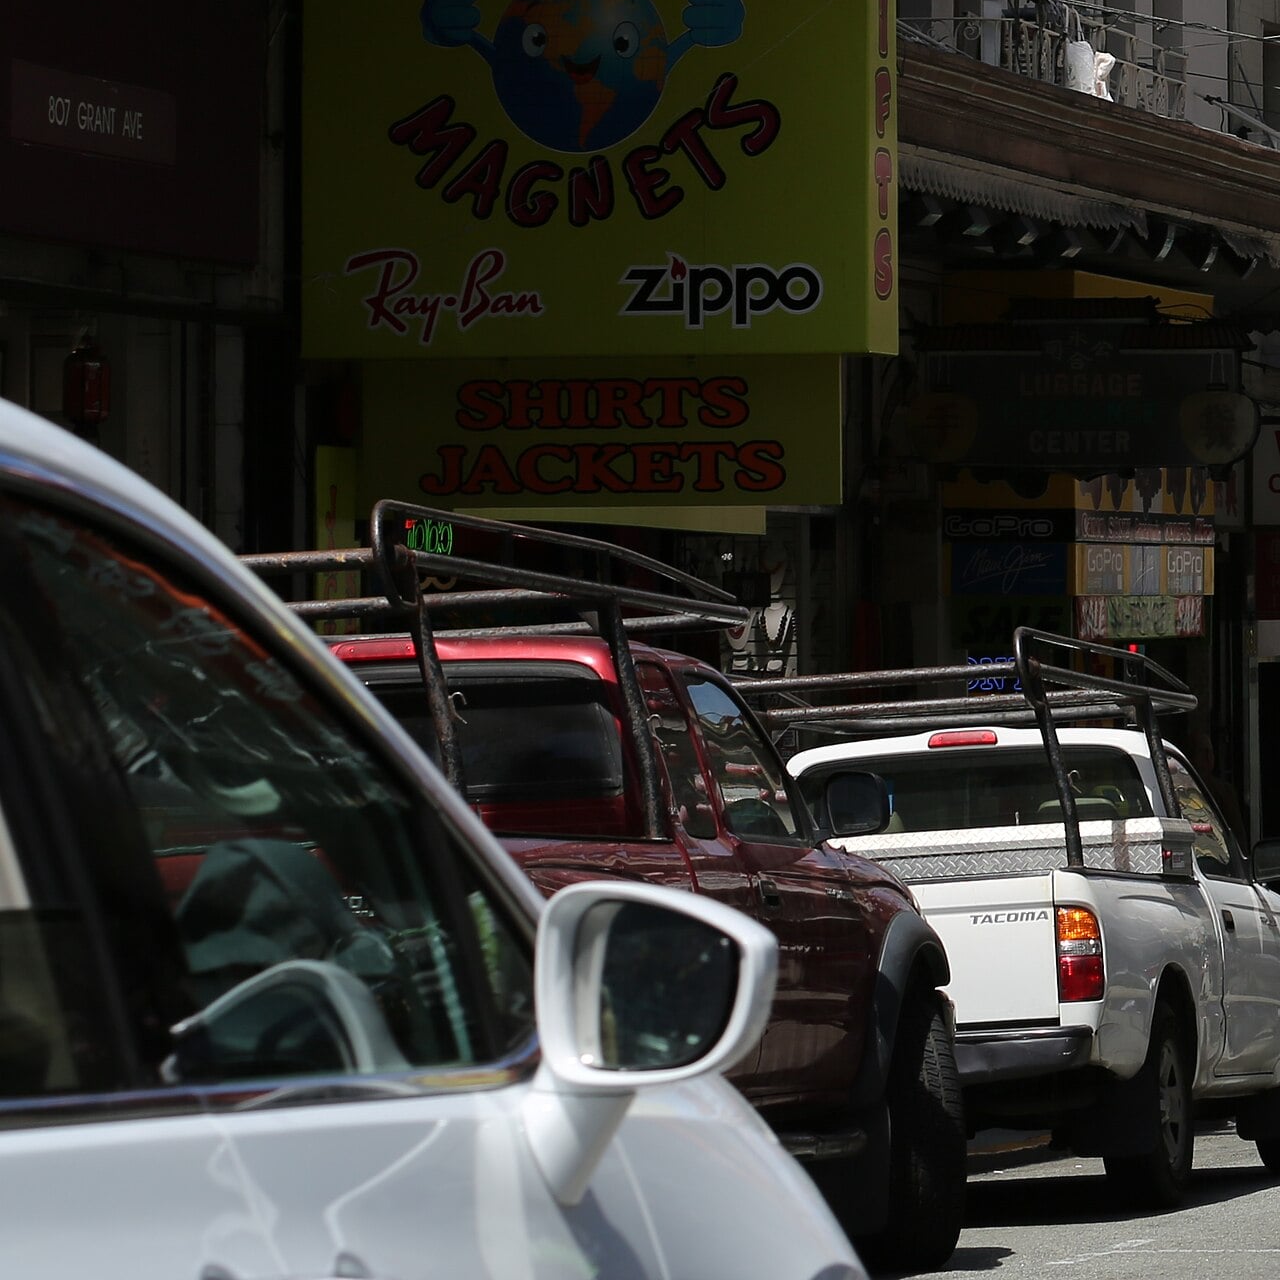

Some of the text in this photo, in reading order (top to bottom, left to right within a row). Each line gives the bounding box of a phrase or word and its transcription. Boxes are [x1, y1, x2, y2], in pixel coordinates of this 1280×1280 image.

[46, 93, 145, 140] 807 GRANT AVE
[387, 71, 783, 228] MAGNETS
[455, 376, 751, 433] SHIRTS
[420, 439, 786, 496] JACKETS
[969, 910, 1050, 926] TACOMA
